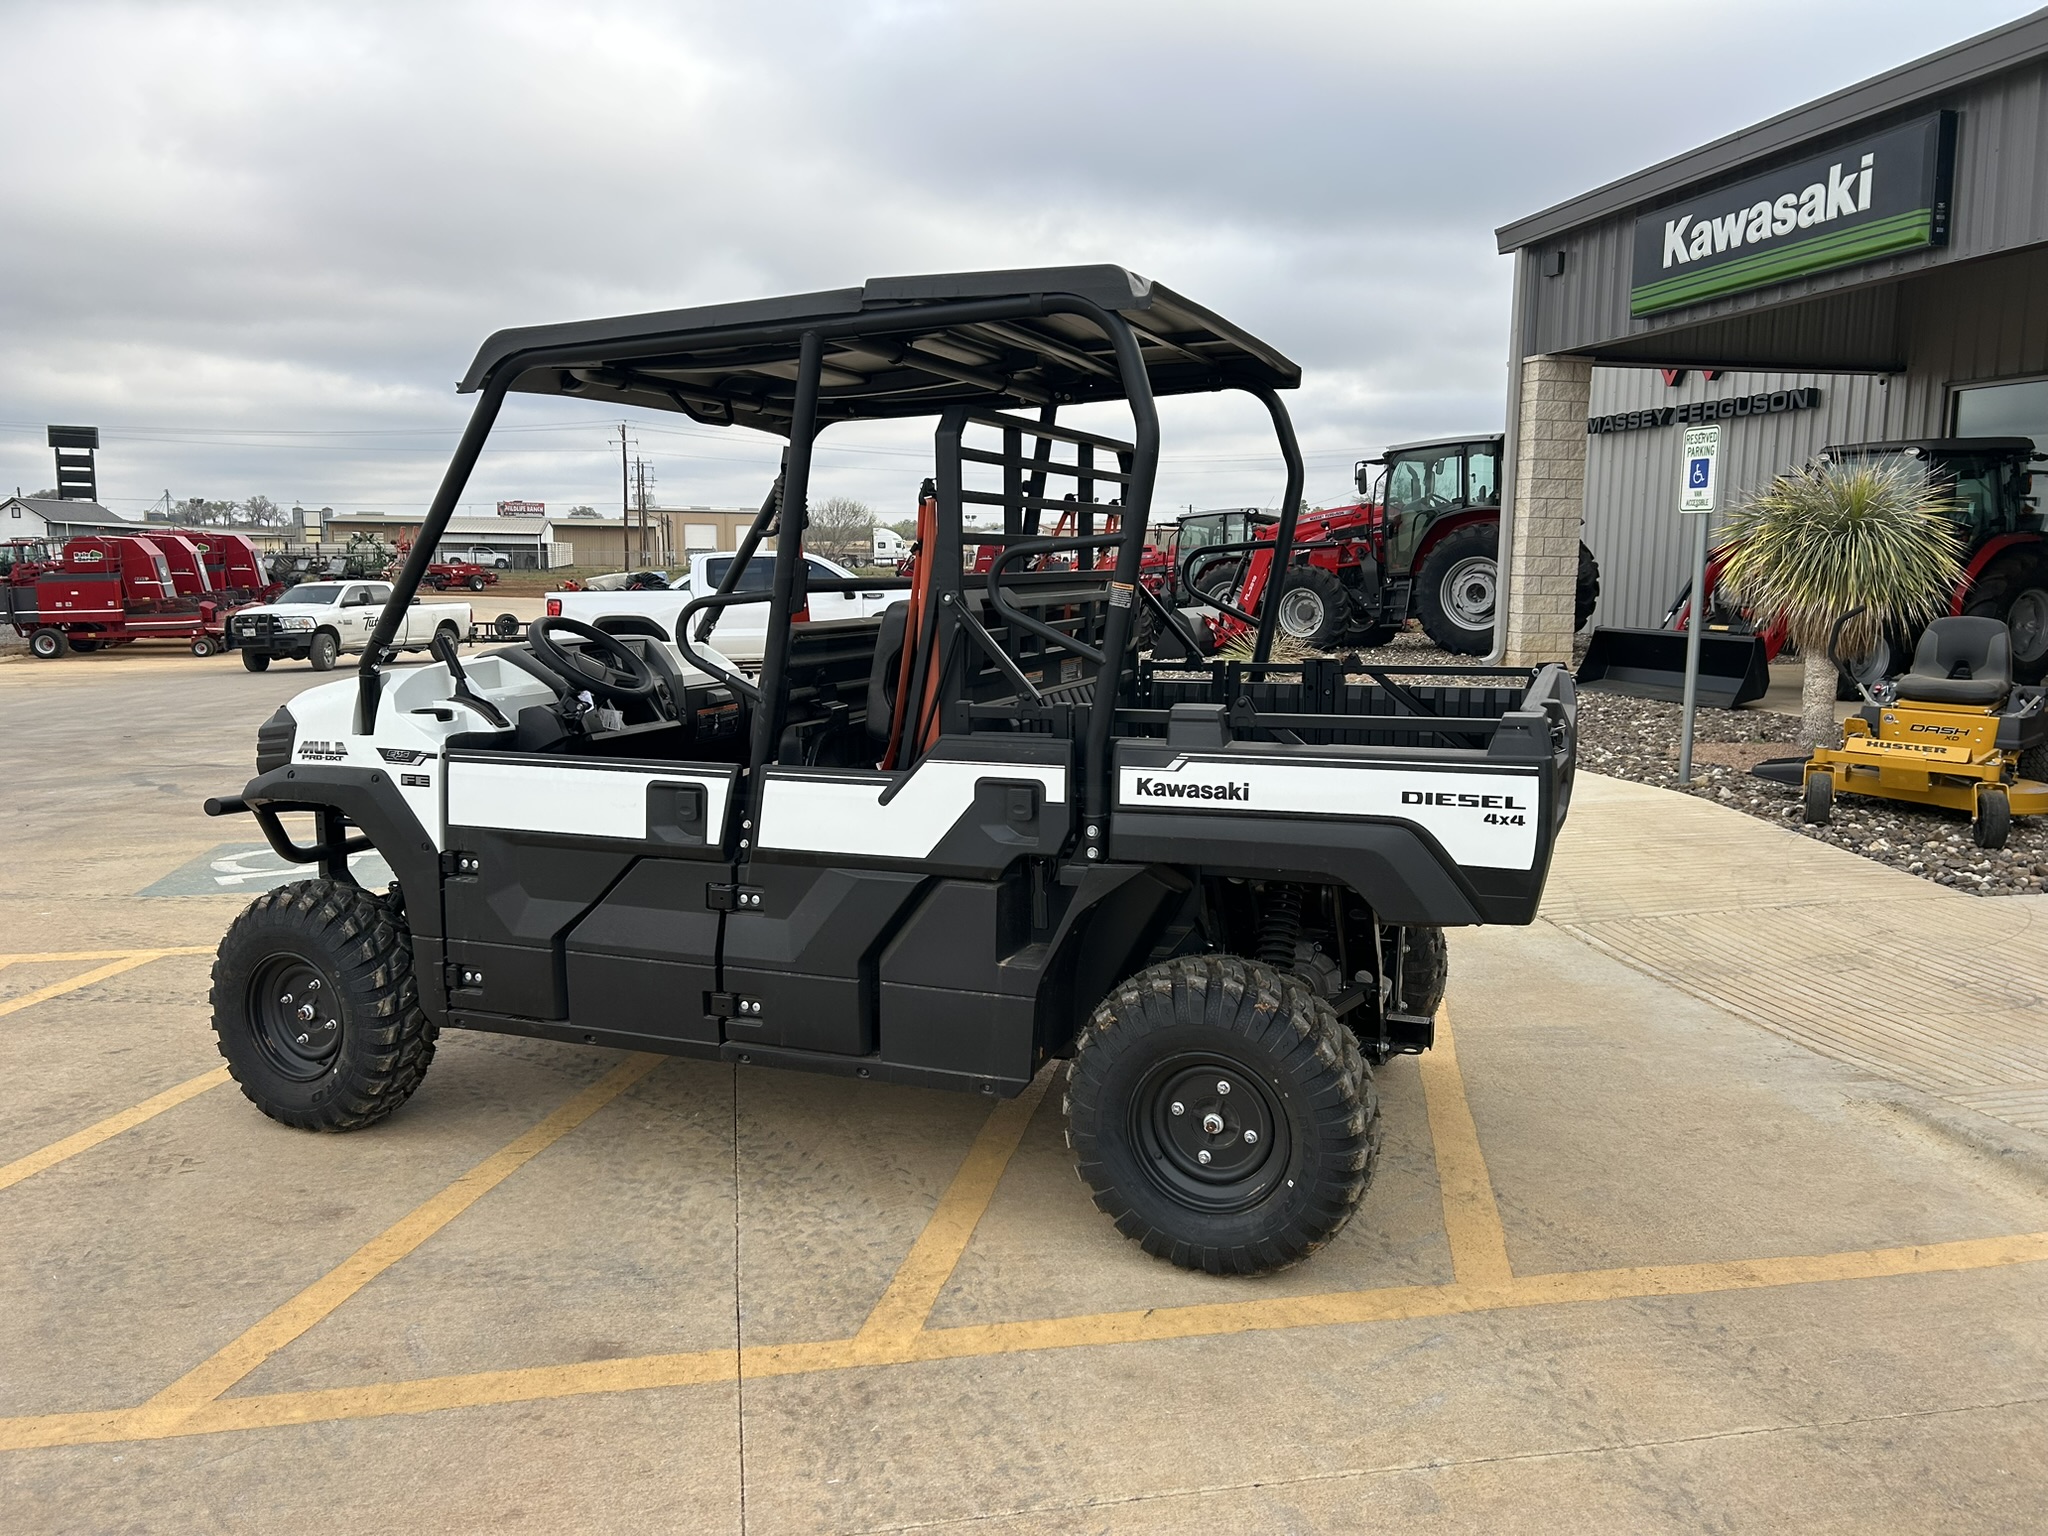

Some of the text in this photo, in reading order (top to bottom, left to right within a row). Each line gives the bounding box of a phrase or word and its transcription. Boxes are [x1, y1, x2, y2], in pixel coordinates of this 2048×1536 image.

[1662, 152, 1875, 269] Kawasaki
[1588, 388, 1809, 434] MASSEY FERGUSON
[1686, 432, 1718, 445] RESERVED
[1687, 445, 1715, 457] PARKING
[1685, 499, 1709, 507] ACCESSIBLE
[362, 616, 379, 631] Tut
[1909, 724, 1970, 736] DASH
[297, 740, 348, 755] MULE
[1866, 740, 1947, 754] HUSTLER
[402, 775, 430, 787] FE
[1136, 777, 1250, 801] Kawasaki
[1401, 791, 1527, 810] DIESEL
[1483, 813, 1526, 826] 4x4
